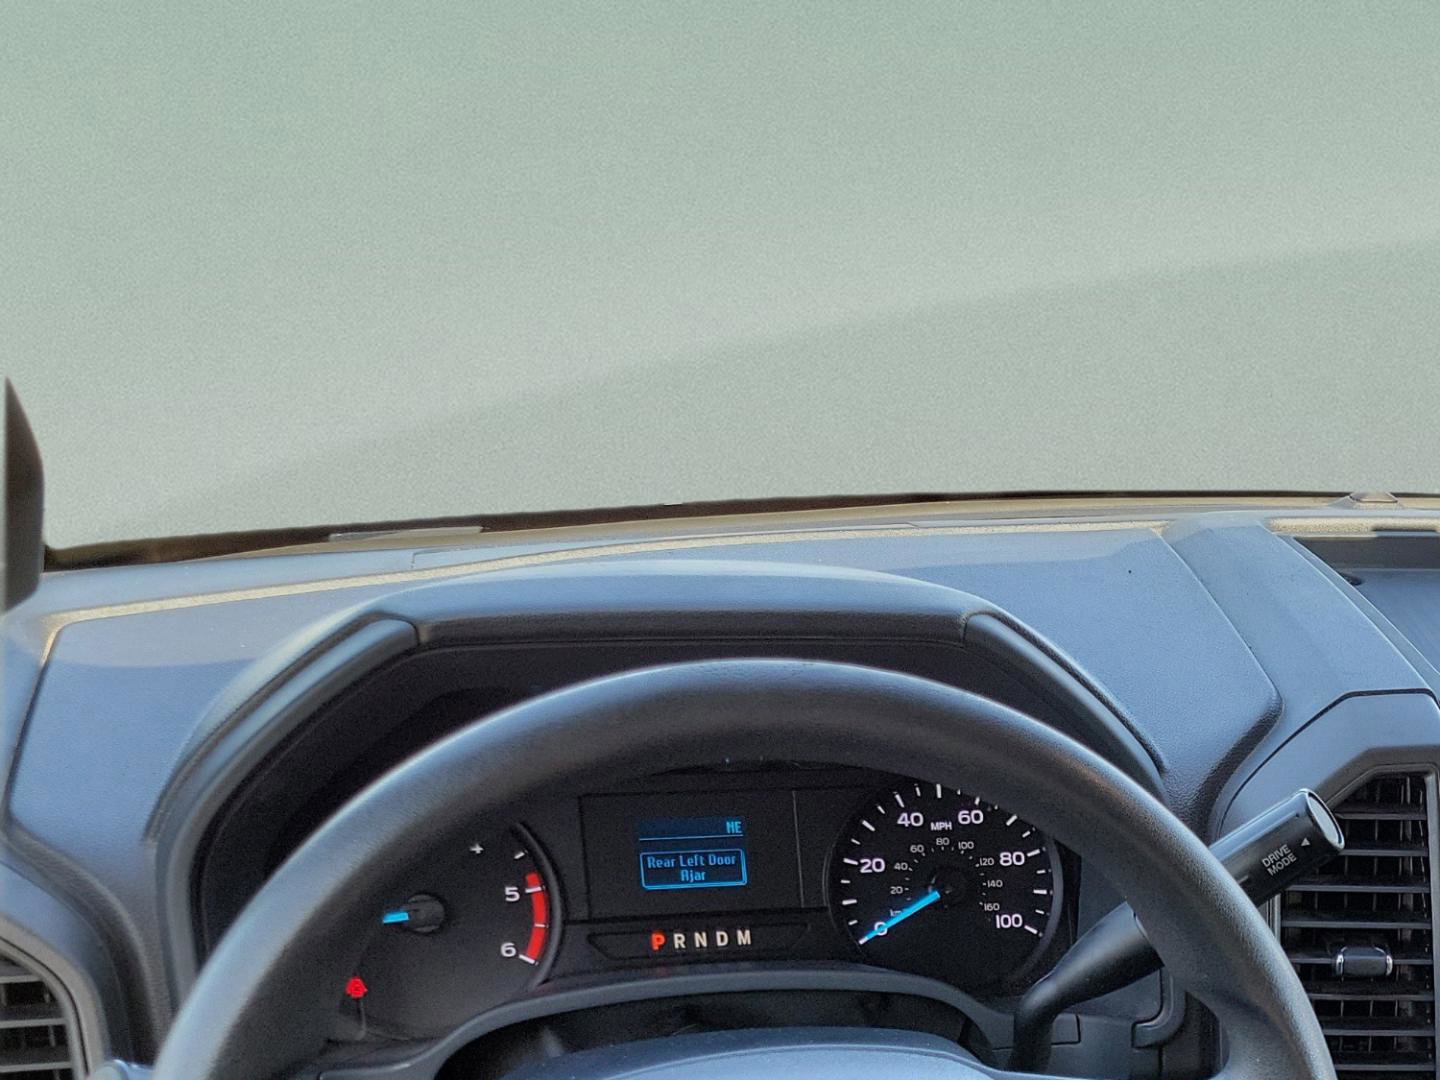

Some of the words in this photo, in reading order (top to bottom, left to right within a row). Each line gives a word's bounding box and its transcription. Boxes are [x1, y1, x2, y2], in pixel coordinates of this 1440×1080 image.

[897, 812, 924, 827] 40
[958, 809, 984, 825] 60
[930, 821, 952, 831] MPH
[910, 844, 925, 853] 60
[935, 837, 950, 846] 80
[958, 841, 975, 850] 100
[647, 856, 676, 869] Rear
[679, 854, 705, 867] Left
[708, 853, 736, 866] Door
[979, 857, 995, 866] 120
[1000, 851, 1025, 866] 80
[1262, 844, 1291, 868] DRIVE
[860, 858, 886, 873] 20
[894, 862, 908, 871] 40
[1267, 852, 1297, 876] MODE
[680, 869, 706, 882] Ajar
[890, 886, 903, 895] 20
[987, 879, 1003, 888] 140
[504, 886, 520, 902] 5
[984, 903, 1000, 911] 160
[995, 913, 1023, 929] 100
[651, 932, 666, 951] P
[673, 932, 686, 949] R
[694, 931, 708, 948] N
[716, 930, 729, 947] D
[736, 928, 752, 946] M
[500, 942, 517, 958] 6
